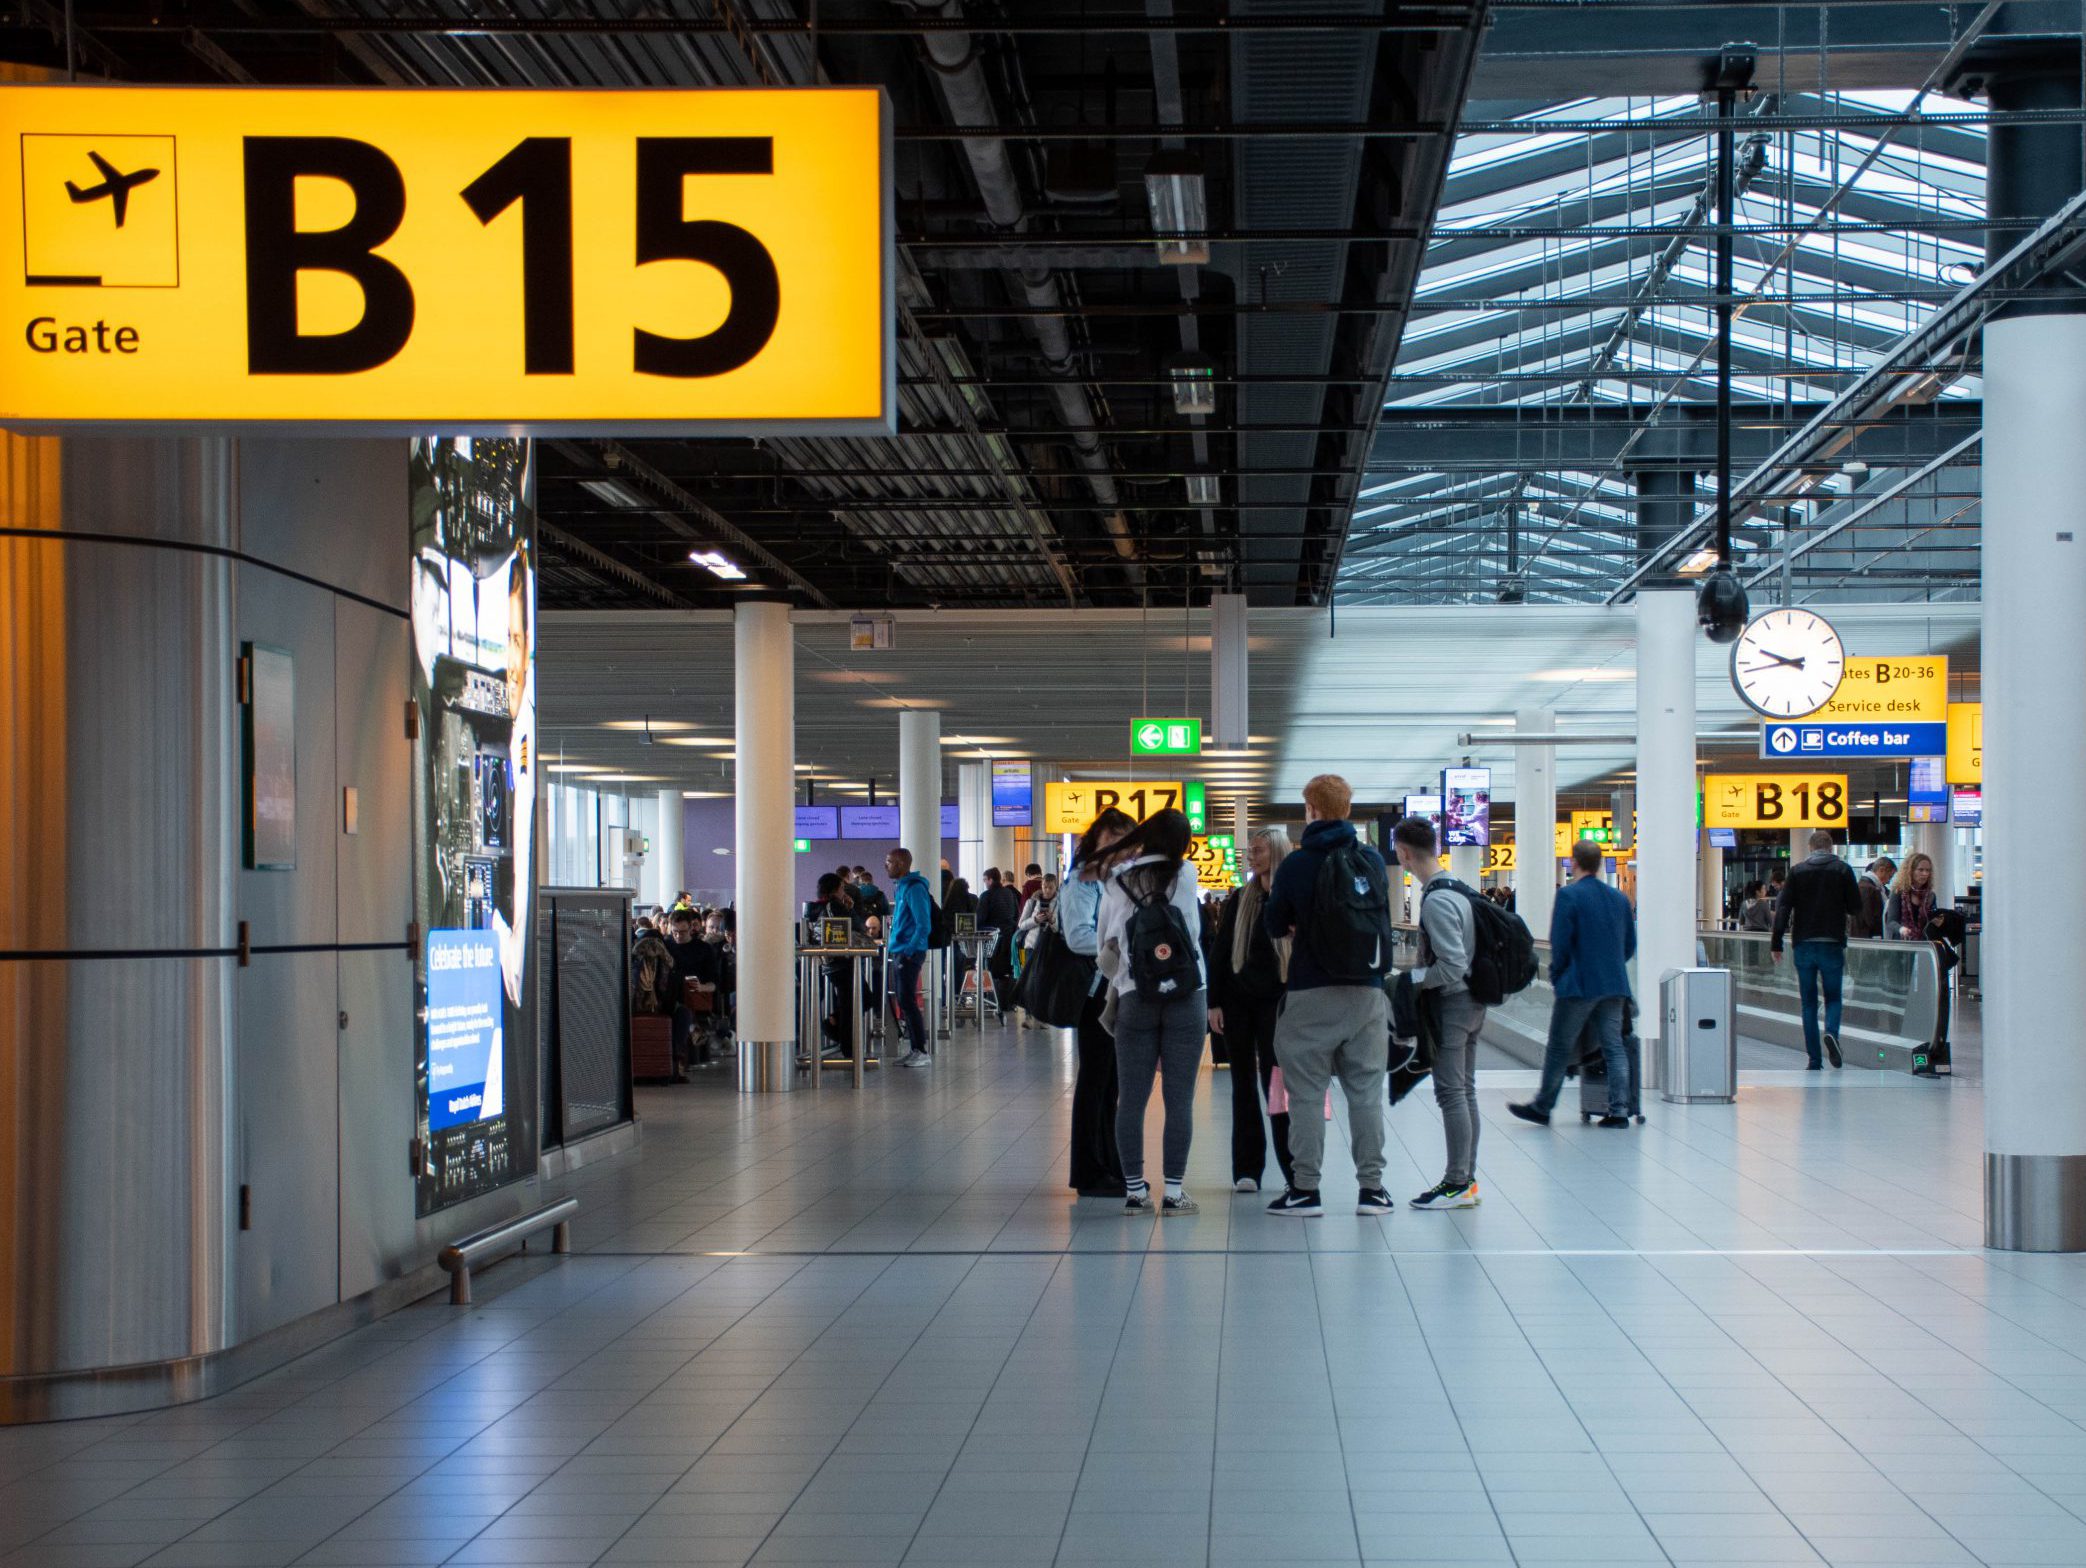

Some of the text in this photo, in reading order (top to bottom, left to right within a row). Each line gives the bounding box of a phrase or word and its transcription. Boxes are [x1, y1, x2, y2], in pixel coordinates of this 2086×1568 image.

[242, 135, 781, 378] B15
[24, 317, 140, 354] Gate
[1841, 668, 1870, 680] ates
[1828, 698, 1921, 713] Service desk
[1827, 731, 1910, 746] Coffee bar
[1756, 781, 1843, 821] B18
[1061, 816, 1080, 824] Gate
[1721, 810, 1740, 818] Gate
[1187, 840, 1216, 862] 23
